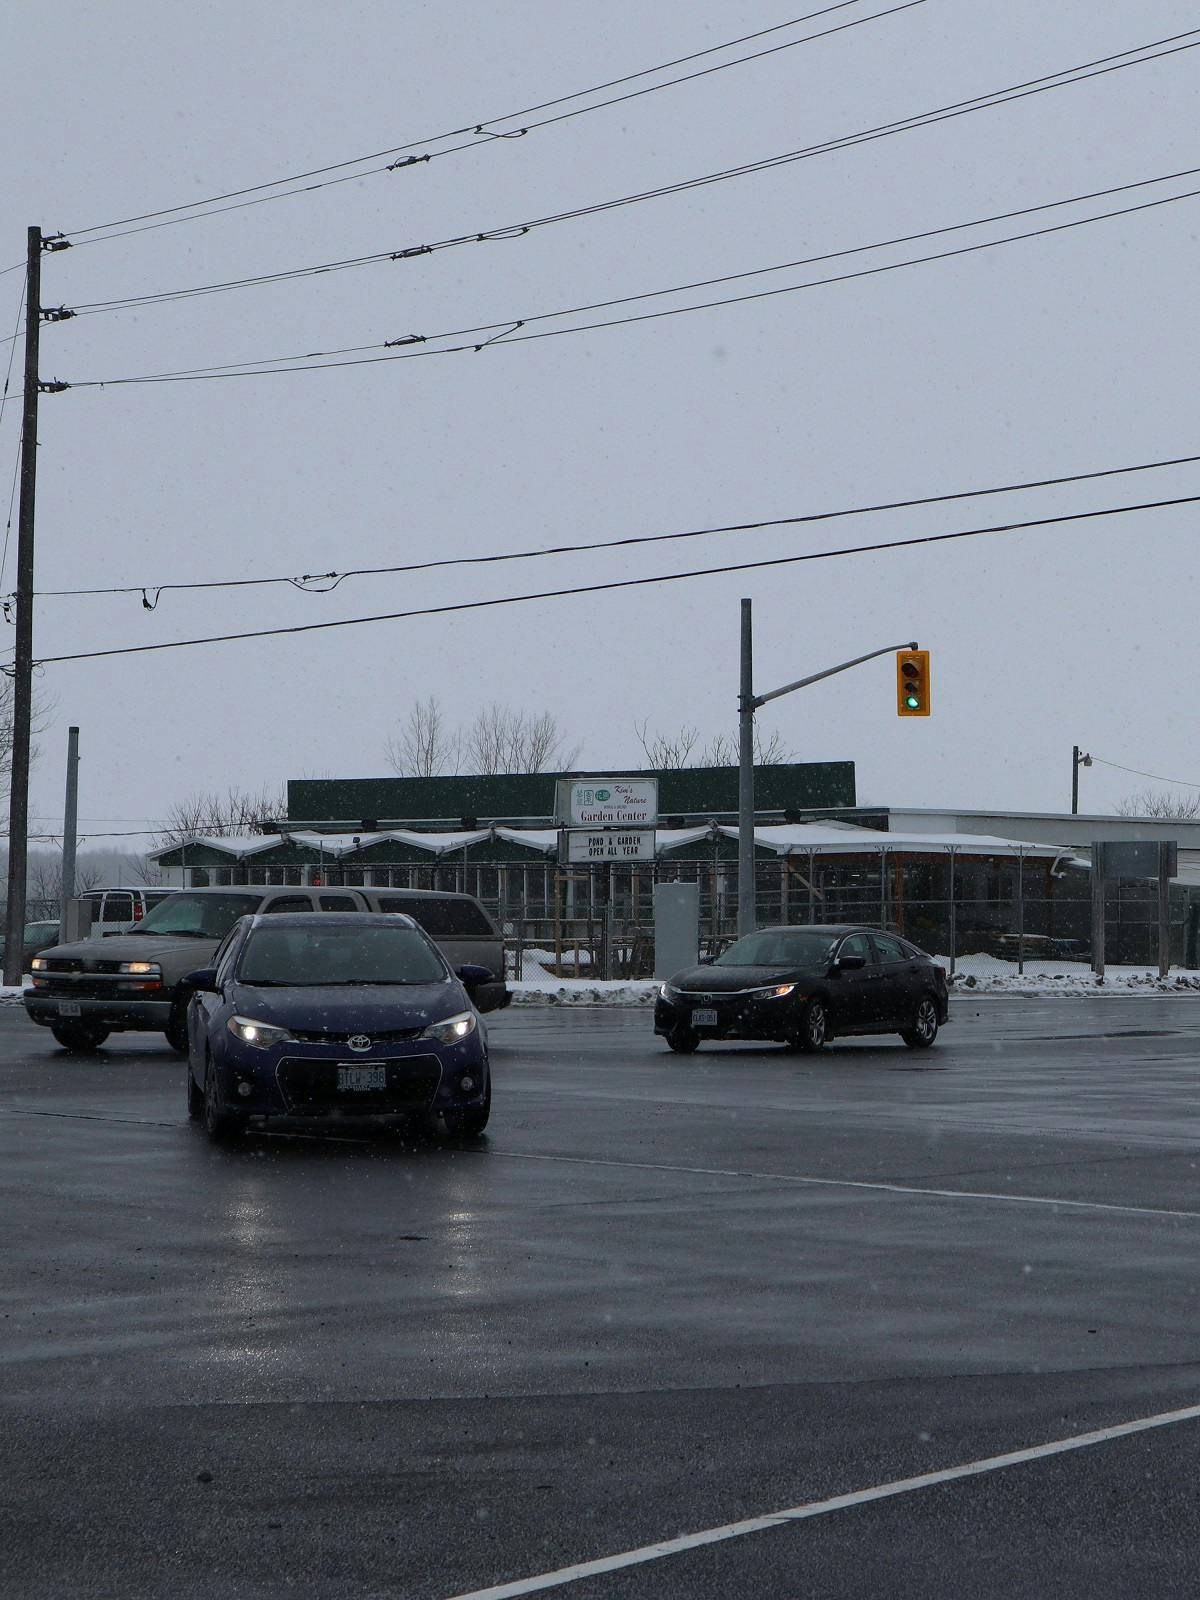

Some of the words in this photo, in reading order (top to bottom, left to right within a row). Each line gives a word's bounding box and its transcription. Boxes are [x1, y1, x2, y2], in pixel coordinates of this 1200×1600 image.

[615, 785, 633, 794] Kim's
[624, 796, 646, 804] Nature
[581, 811, 613, 821] Garden
[617, 811, 647, 820] Center
[588, 838, 604, 847] POND
[618, 837, 640, 845] GARDEN
[589, 848, 604, 856] OPEN
[608, 847, 617, 856] ALL
